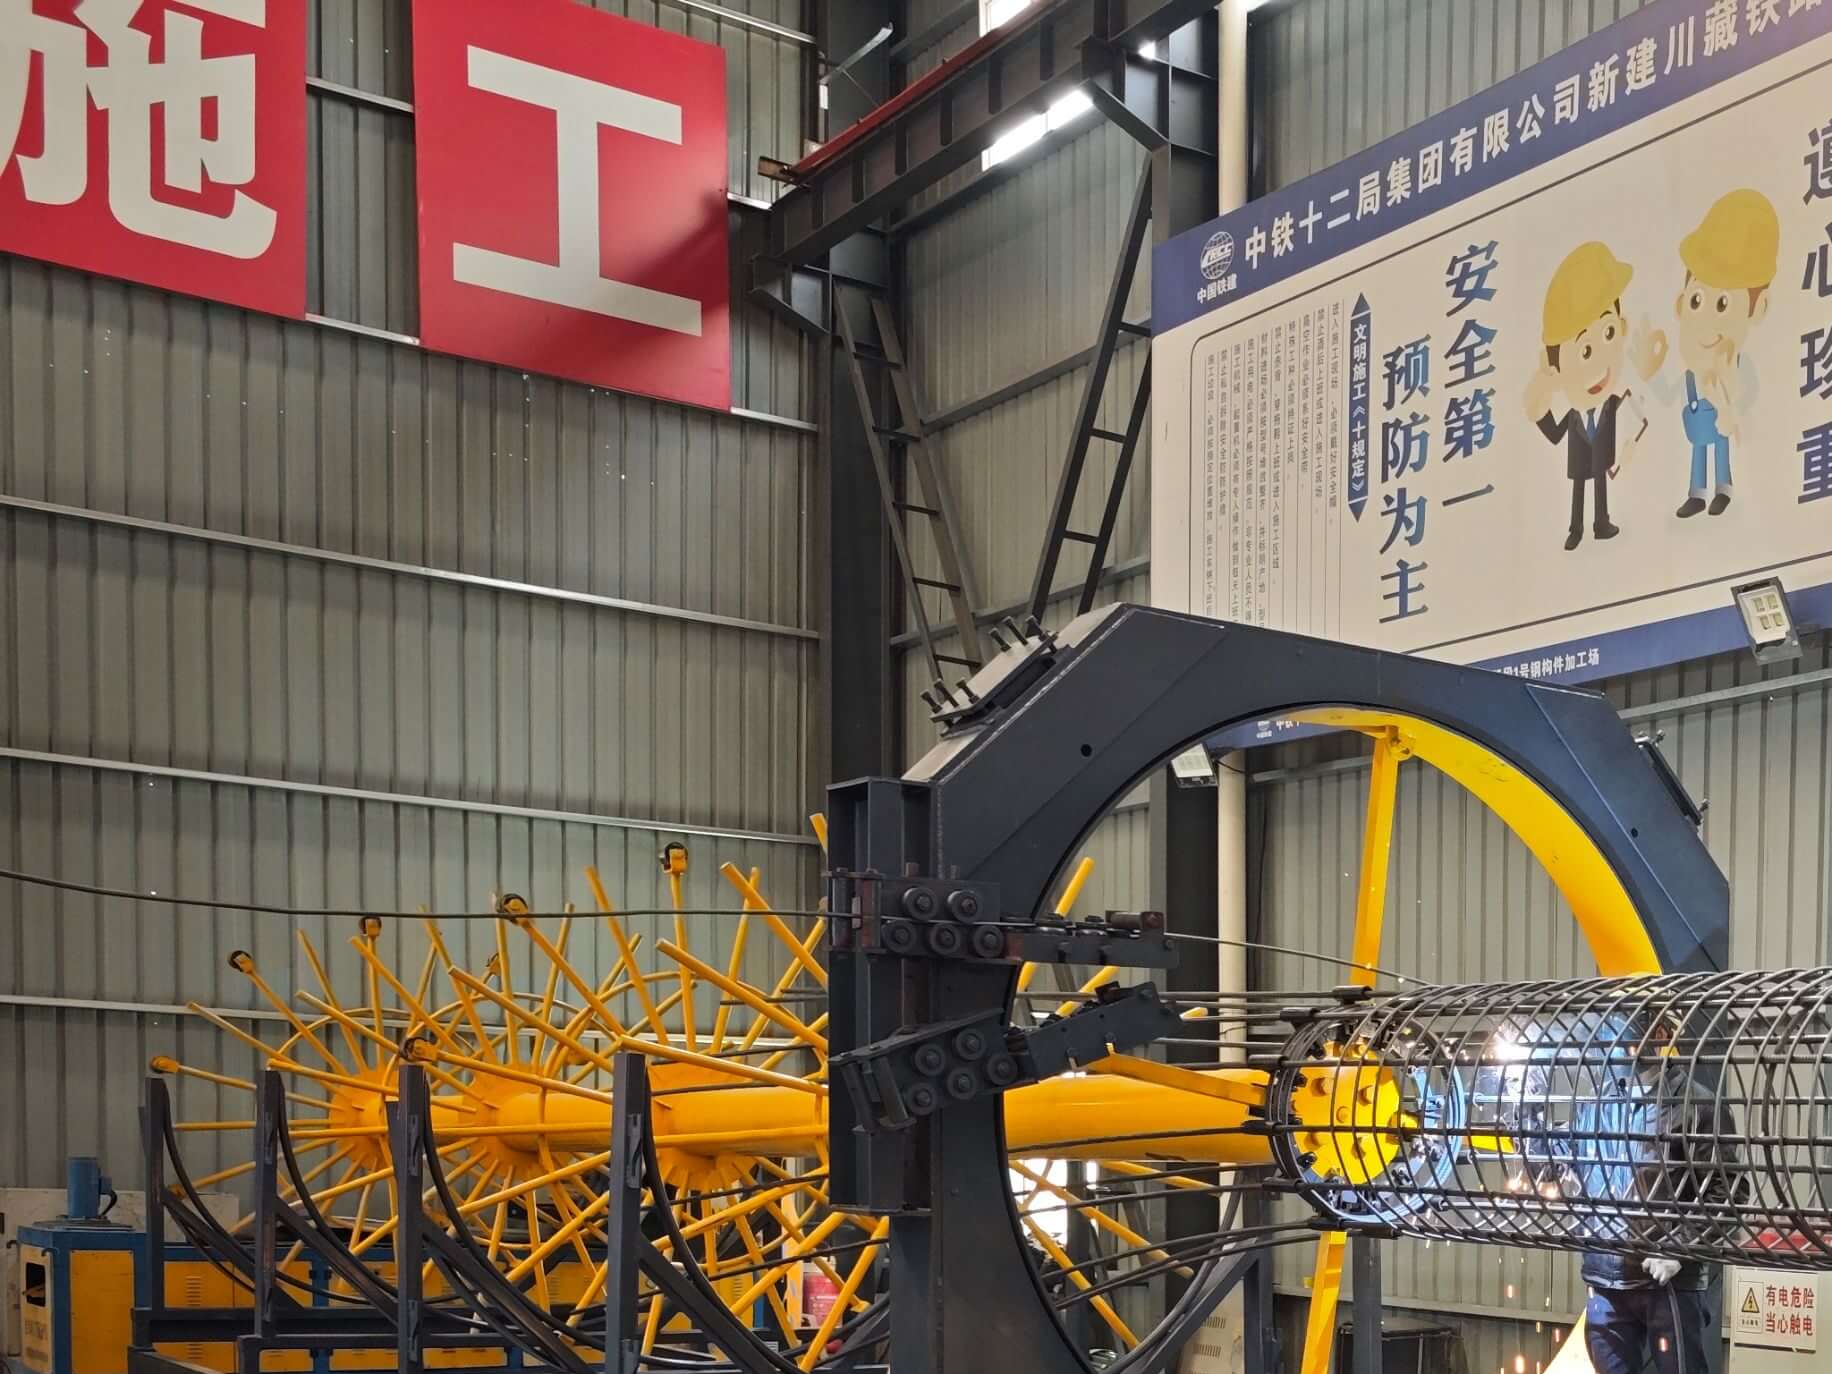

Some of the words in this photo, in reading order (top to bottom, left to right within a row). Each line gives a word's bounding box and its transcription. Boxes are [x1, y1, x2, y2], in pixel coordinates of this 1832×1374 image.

[0, 0, 278, 261] 施
[452, 44, 703, 337] 工
[1196, 273, 1238, 305] 中国铁建
[1442, 239, 1499, 507] 安全第一
[1378, 334, 1432, 625] 预防为主
[1495, 647, 1601, 681] 1号钢构件加工场
[1765, 1284, 1815, 1309] 有电危险
[1765, 1311, 1814, 1337] 当心触电
